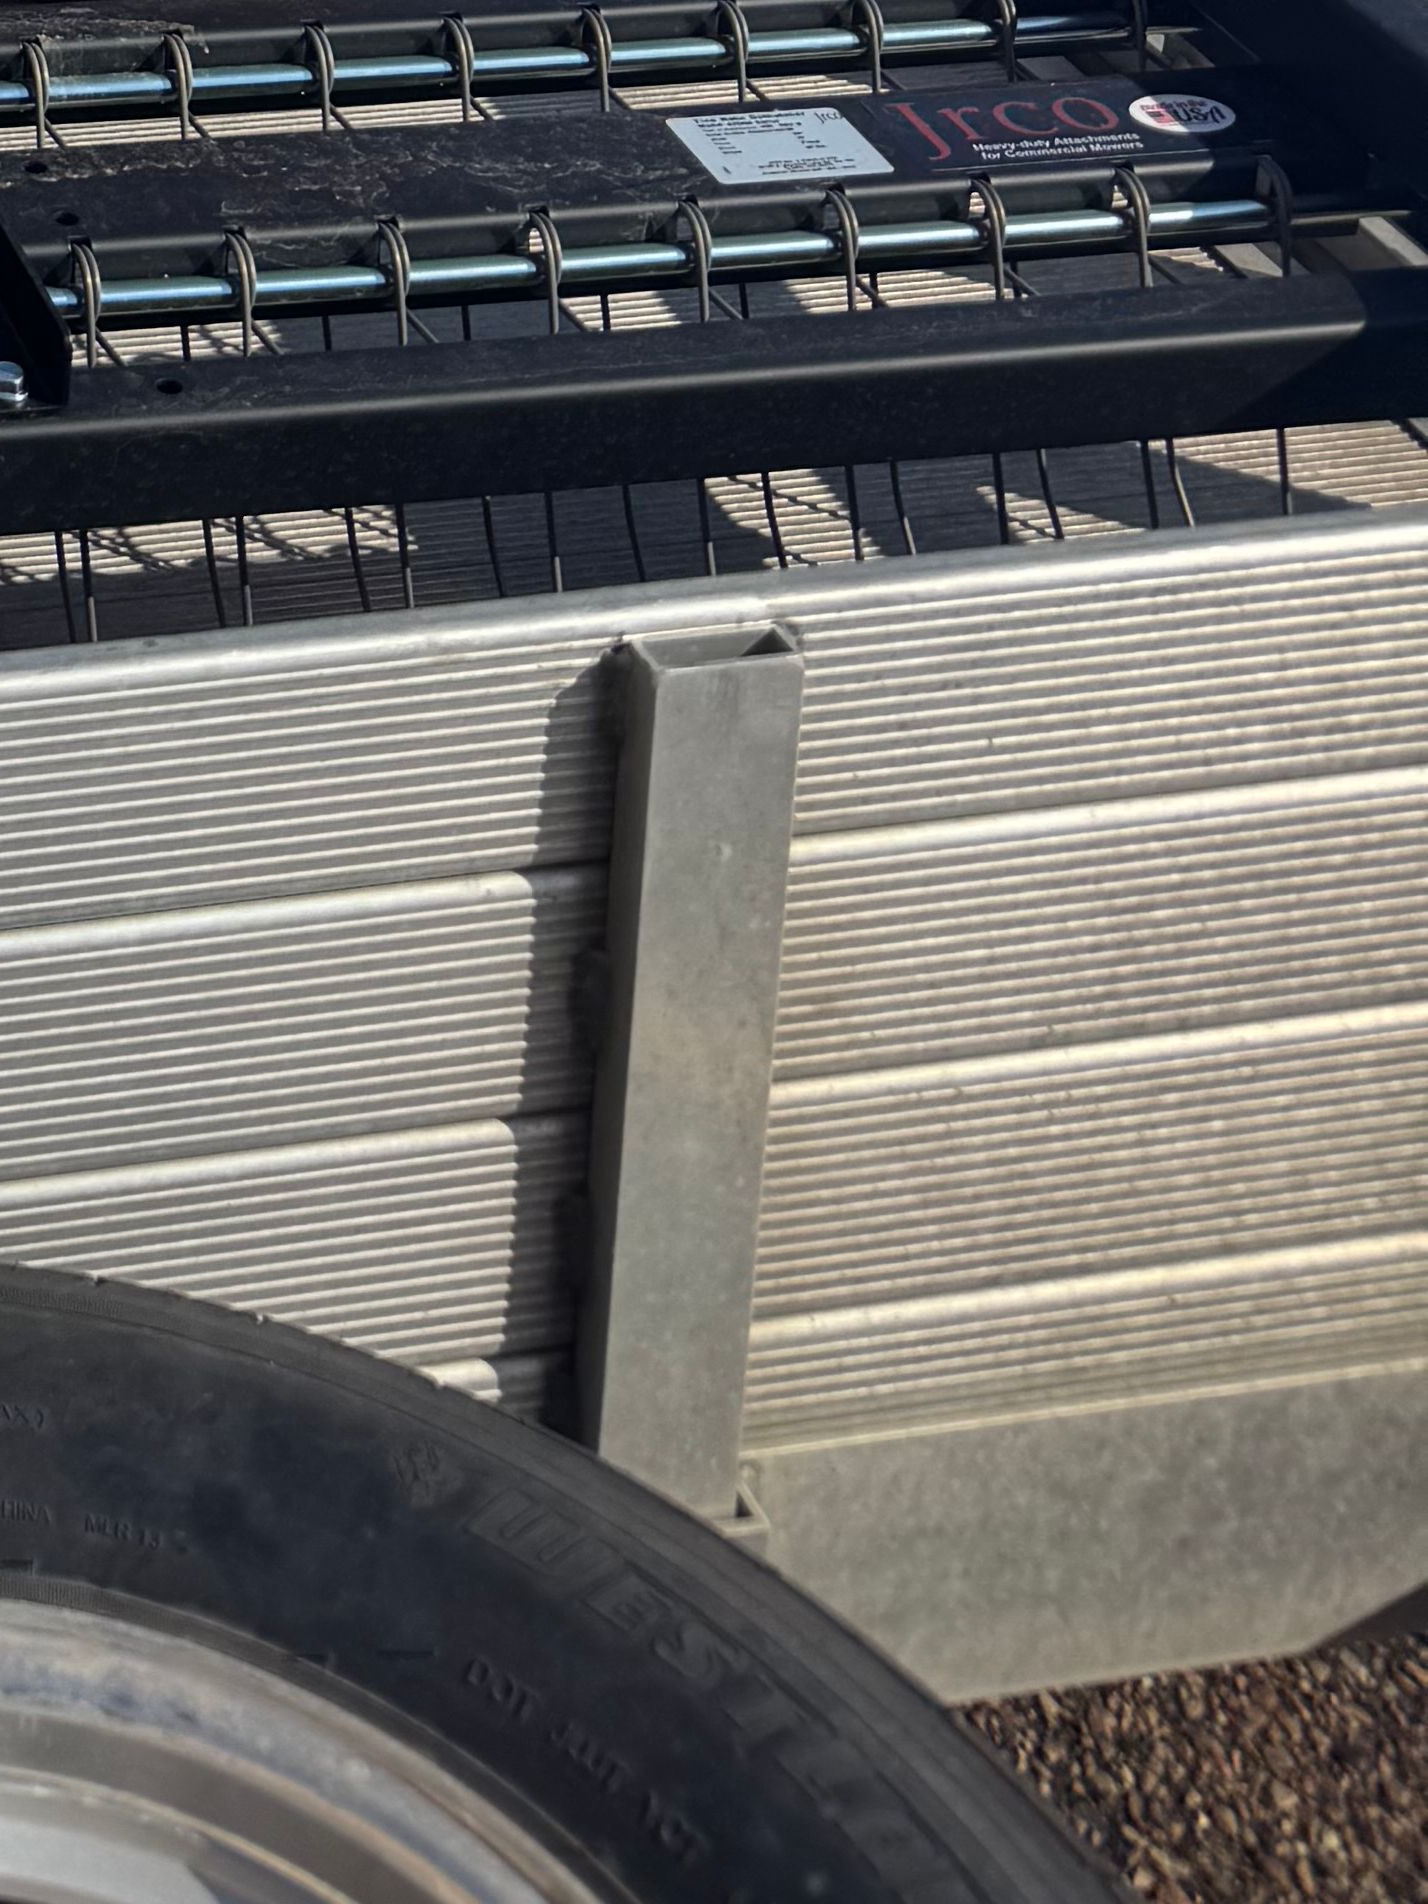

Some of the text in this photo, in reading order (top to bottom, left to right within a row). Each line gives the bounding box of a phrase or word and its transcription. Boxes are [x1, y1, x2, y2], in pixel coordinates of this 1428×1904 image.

[1174, 104, 1227, 124] USA
[972, 132, 1141, 153] Heavy-duty Attachments
[981, 141, 1145, 161] for Commercial Mowers
